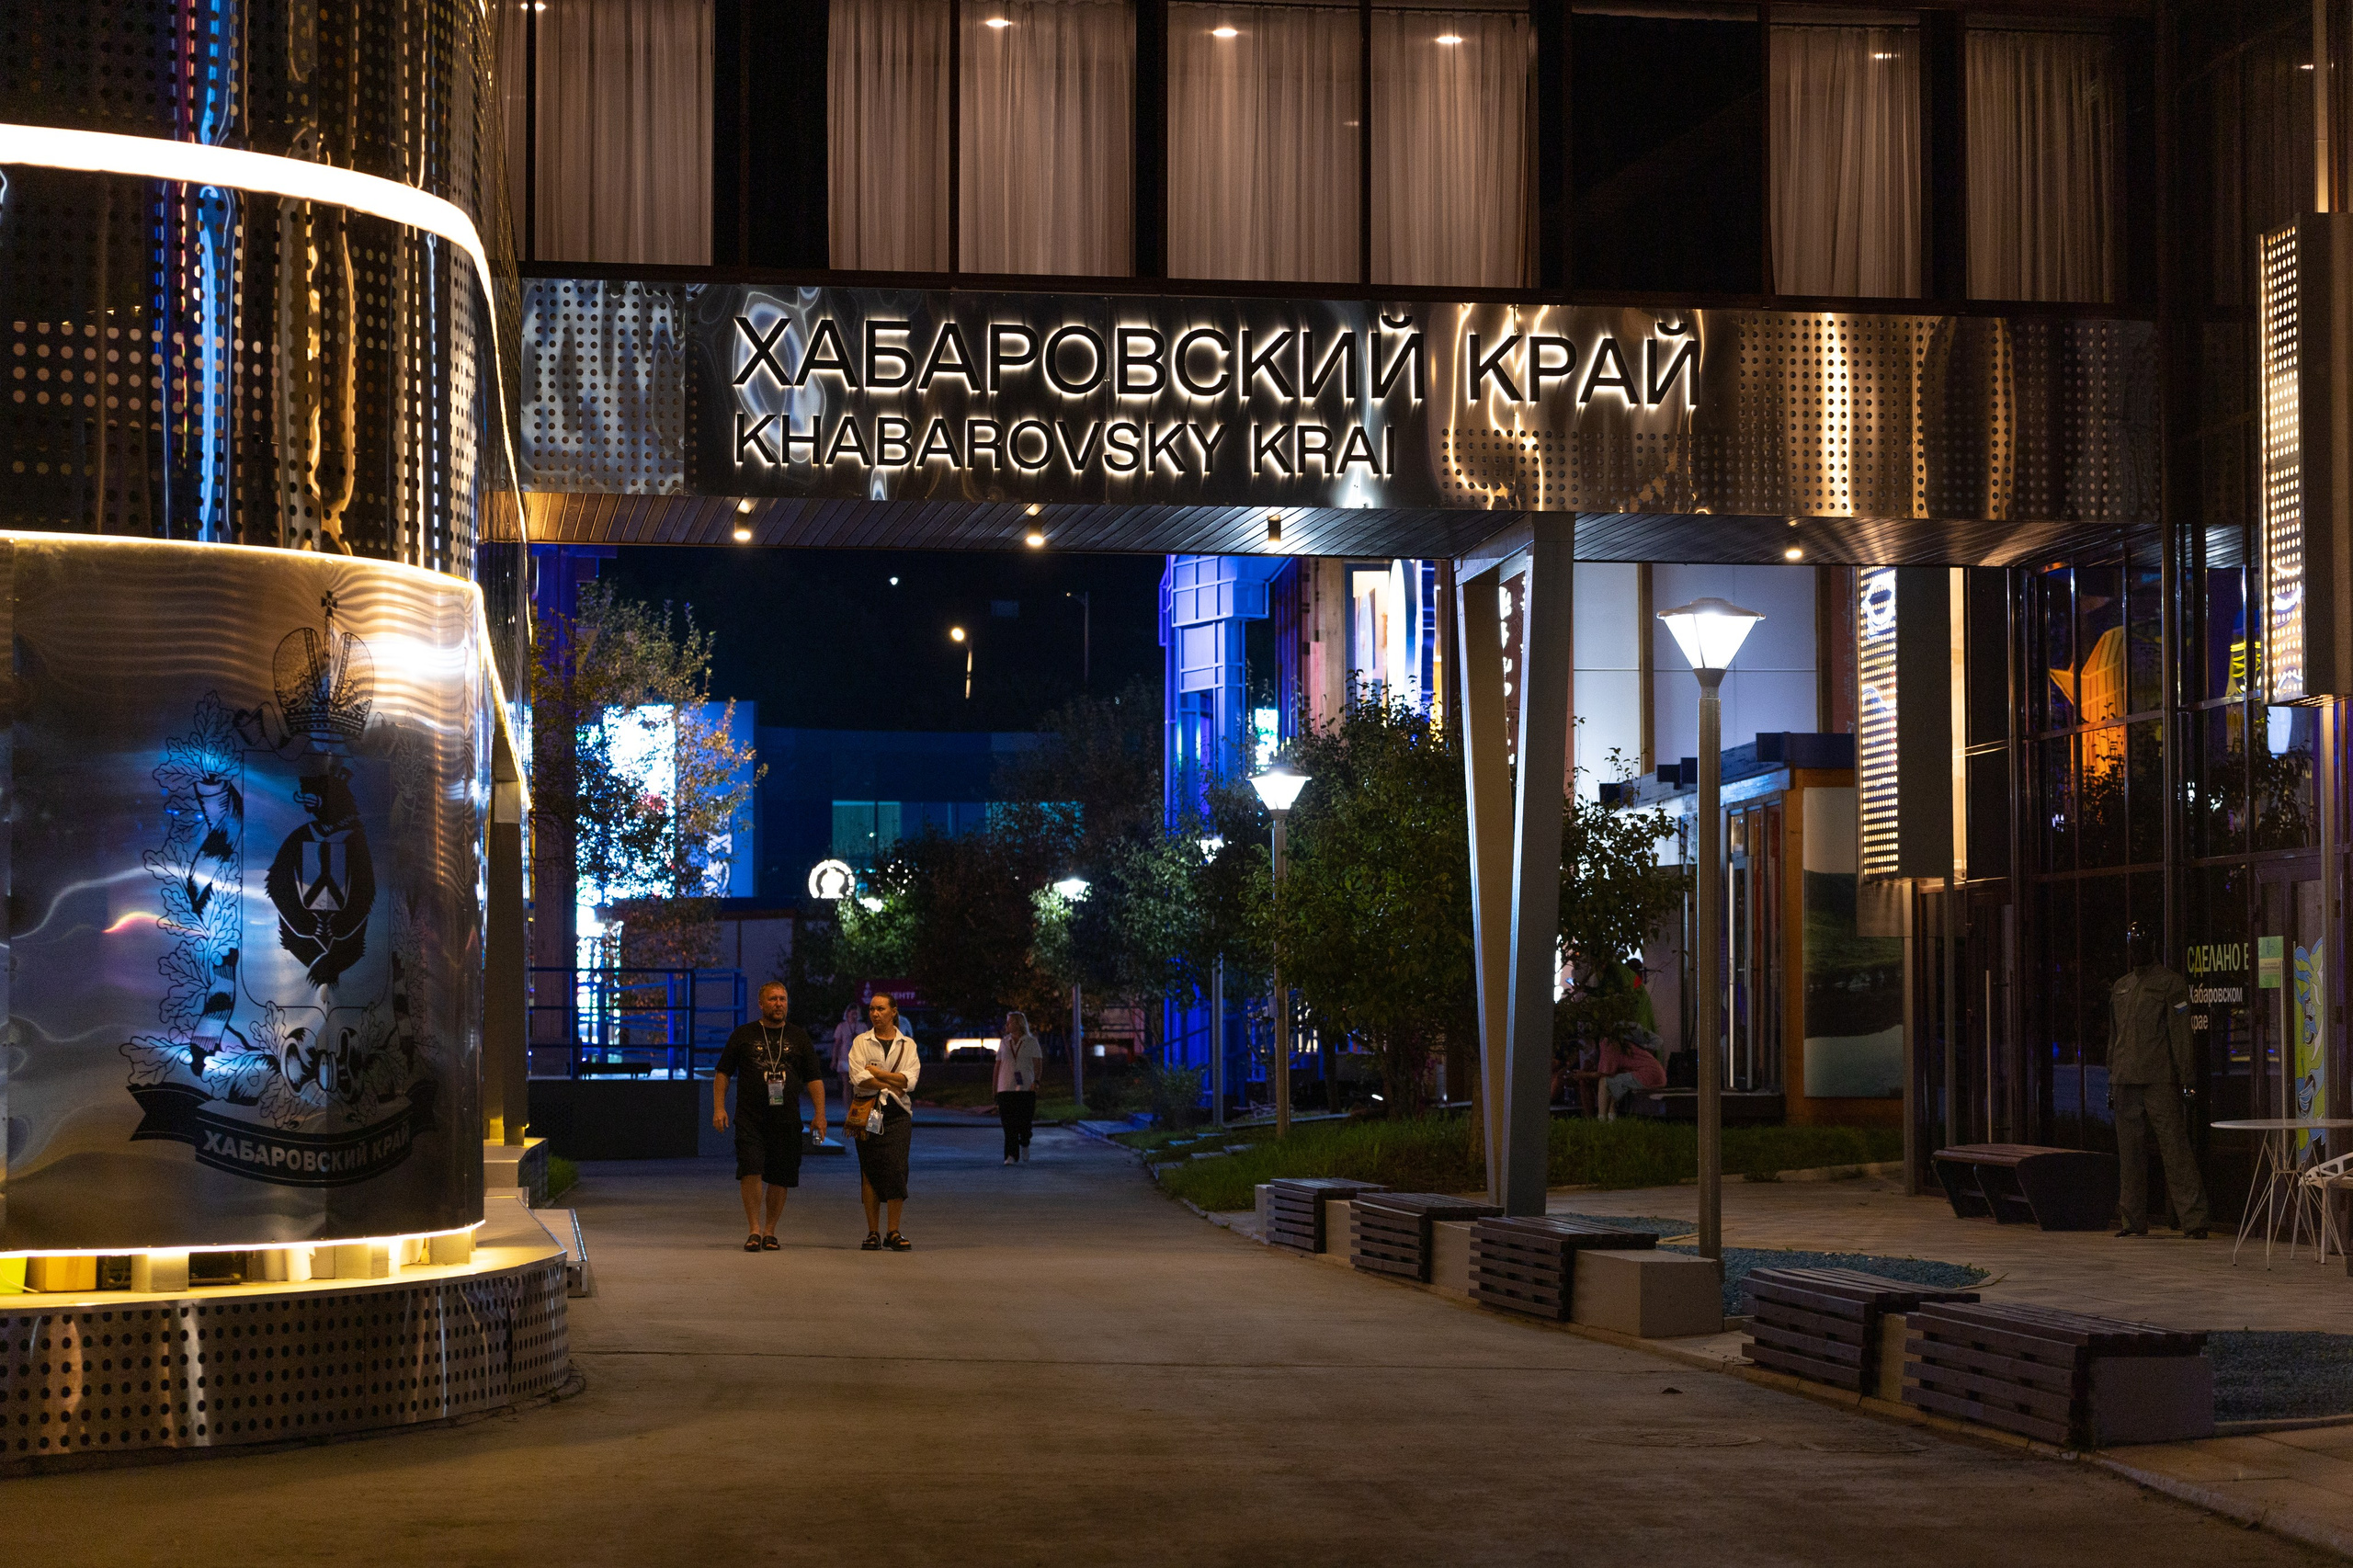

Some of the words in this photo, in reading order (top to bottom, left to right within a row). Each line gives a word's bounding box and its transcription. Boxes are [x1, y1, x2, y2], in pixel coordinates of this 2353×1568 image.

[733, 315, 1425, 400] ХАБАРОВСКИЙ
[1469, 321, 1700, 406] КРАЙ
[735, 414, 1229, 472] KHABAROVSKY
[1253, 424, 1395, 475] KRAI
[2188, 943, 2241, 978] СДЕЛАНО
[2188, 982, 2243, 1007] Хабаровском
[203, 1129, 368, 1173] ХАБАРОВСКИЙ
[371, 1119, 412, 1162] КРАЙ
